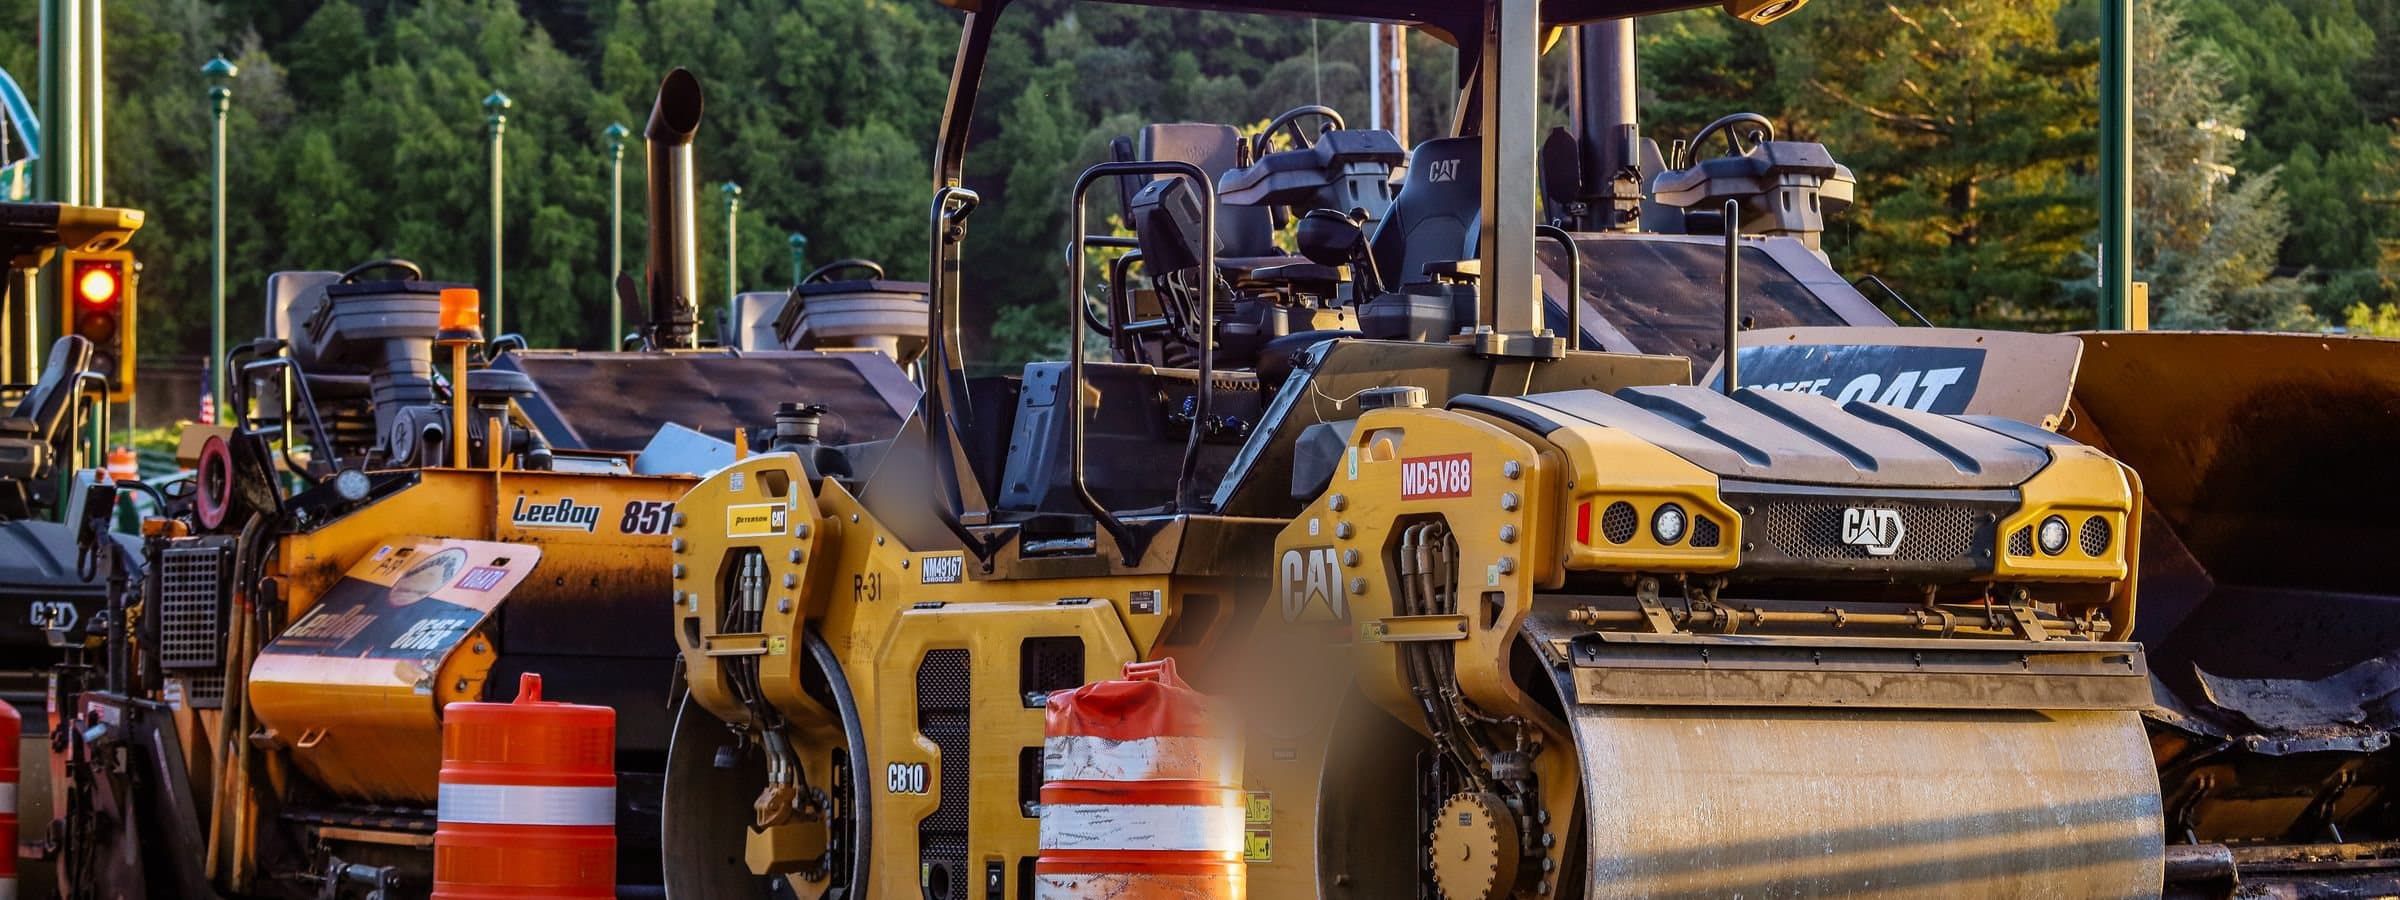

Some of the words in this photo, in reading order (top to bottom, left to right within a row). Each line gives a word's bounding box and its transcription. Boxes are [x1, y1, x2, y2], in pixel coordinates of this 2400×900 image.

[1428, 159, 1461, 183] CAT
[1402, 459, 1471, 496] MD5V88
[511, 497, 600, 533] LeeBoy
[771, 511, 785, 528] CAT
[1842, 508, 1893, 546] CAT
[922, 556, 962, 577] NM49167
[853, 571, 881, 602] R-31
[1281, 548, 1343, 624] CAT
[282, 603, 379, 650] LeeBoy
[887, 762, 924, 793] CB10
